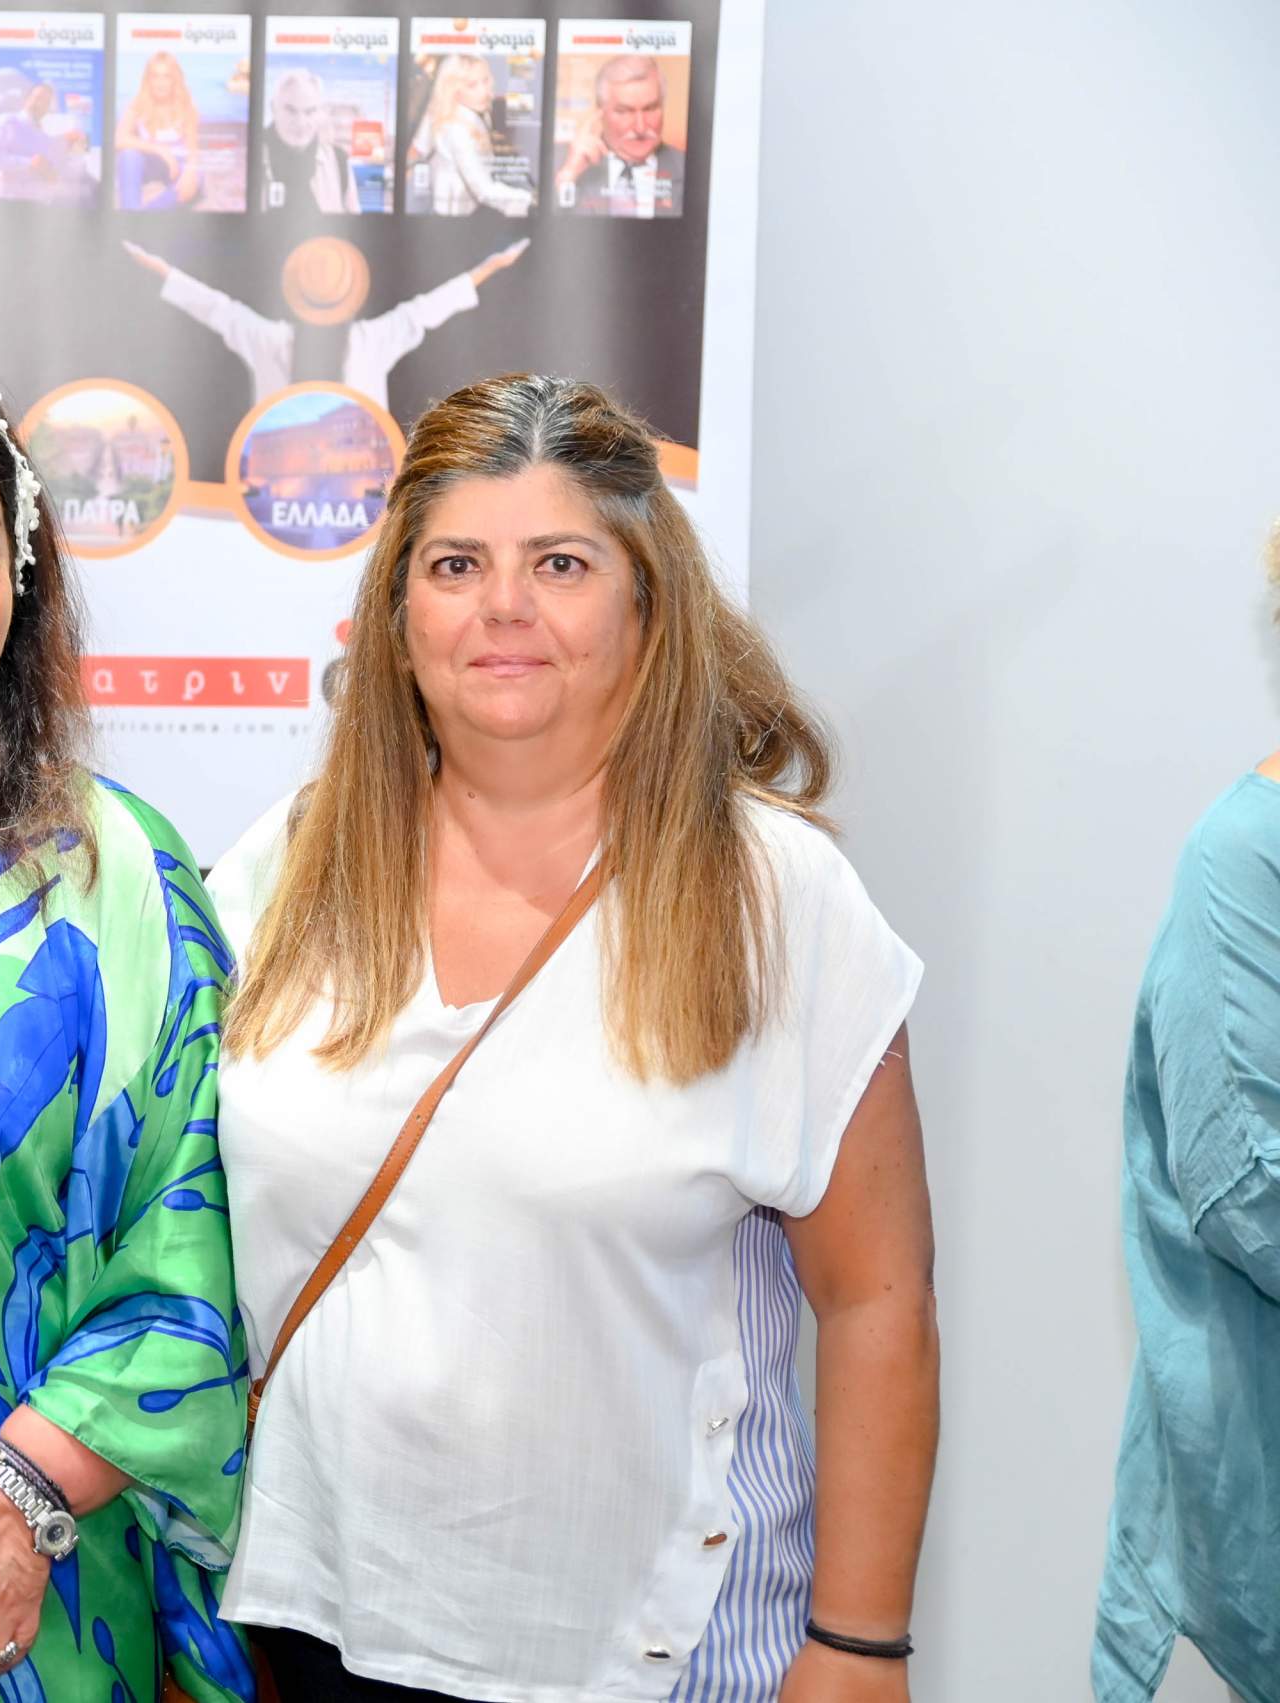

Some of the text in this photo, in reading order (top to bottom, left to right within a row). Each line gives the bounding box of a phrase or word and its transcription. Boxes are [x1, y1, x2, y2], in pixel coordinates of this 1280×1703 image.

[63, 499, 141, 524] ΠΑΤΡΑ
[271, 501, 369, 528] ΕΛΛΑΔΑ
[91, 669, 290, 700] ατριν
